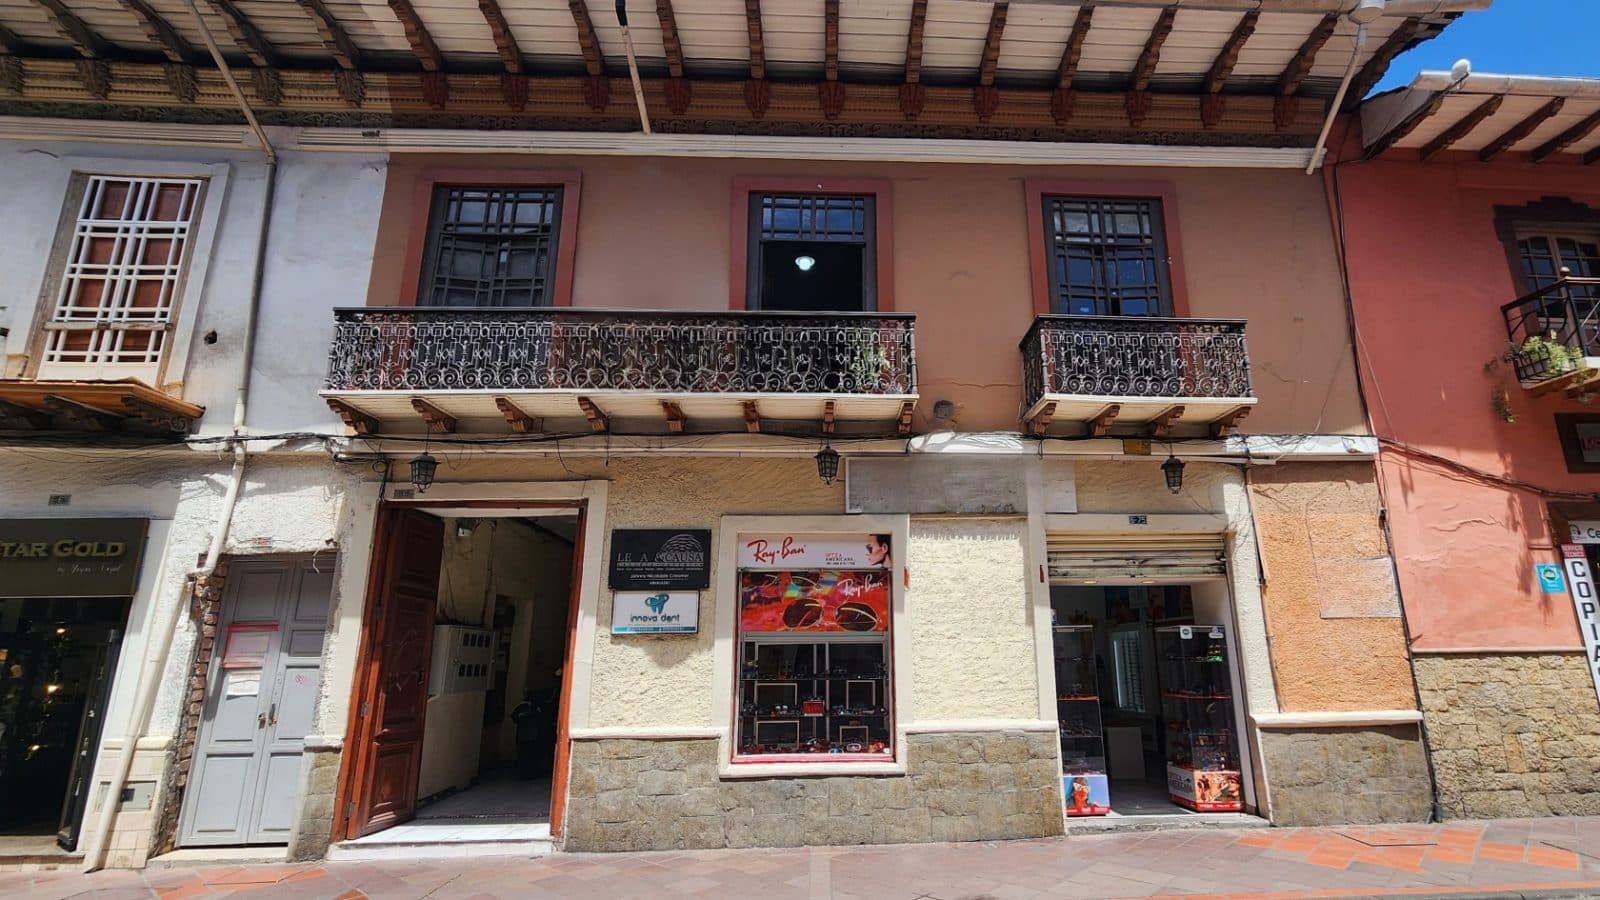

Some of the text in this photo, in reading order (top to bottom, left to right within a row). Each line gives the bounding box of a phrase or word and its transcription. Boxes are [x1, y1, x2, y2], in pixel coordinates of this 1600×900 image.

[0, 539, 125, 558] TAR GOLD
[630, 614, 657, 622] innova
[1571, 561, 1600, 675] COPIA
